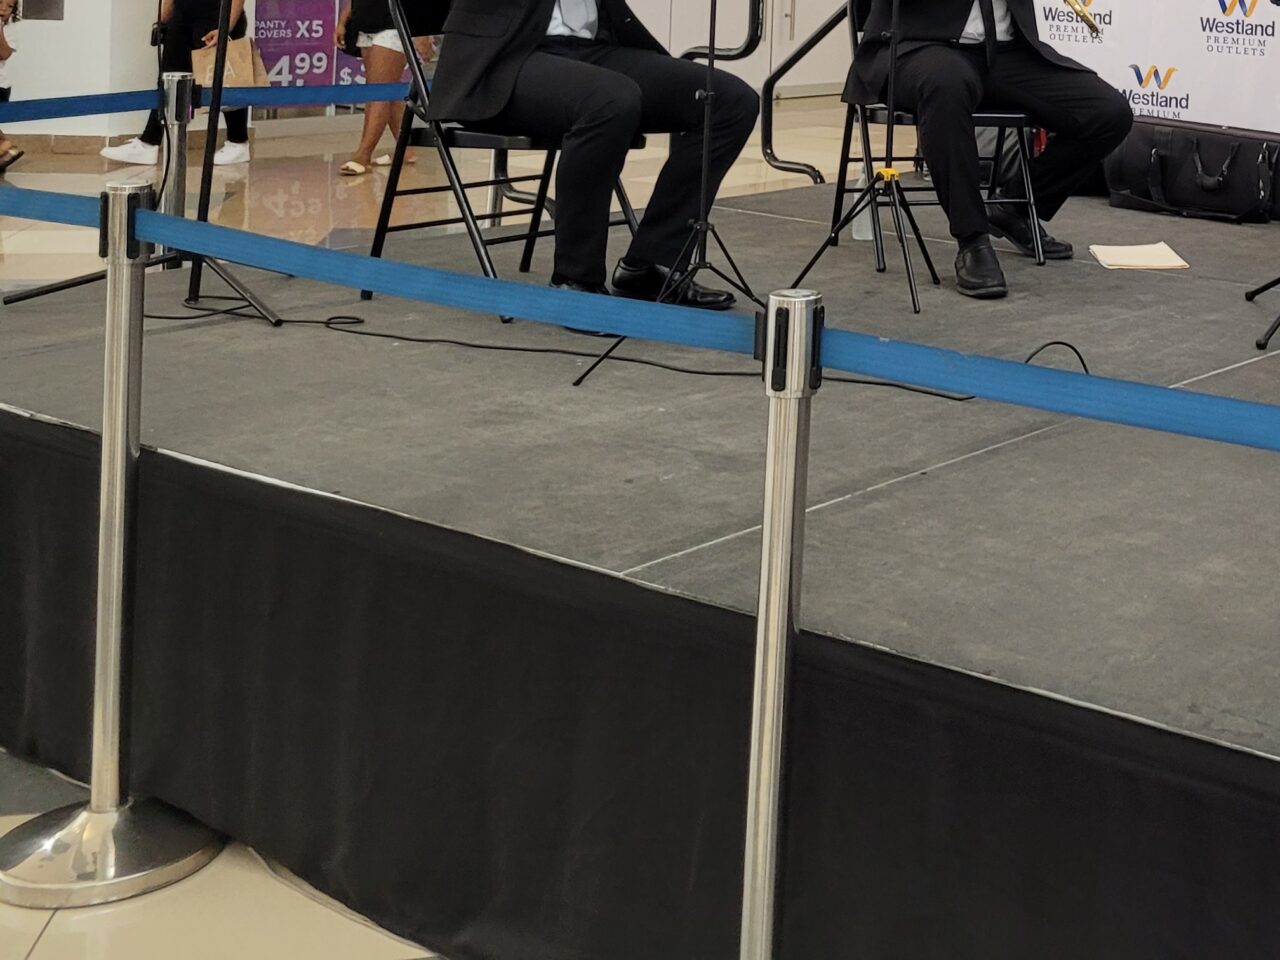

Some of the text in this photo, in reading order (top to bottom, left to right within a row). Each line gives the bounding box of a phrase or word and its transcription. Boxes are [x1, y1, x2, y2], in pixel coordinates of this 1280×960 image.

[296, 20, 324, 38] X5
[1200, 17, 1275, 37] Westland
[1207, 35, 1266, 47] PREMIUM
[1207, 45, 1264, 56] OUTLETS
[1132, 108, 1181, 119] REMIUM
